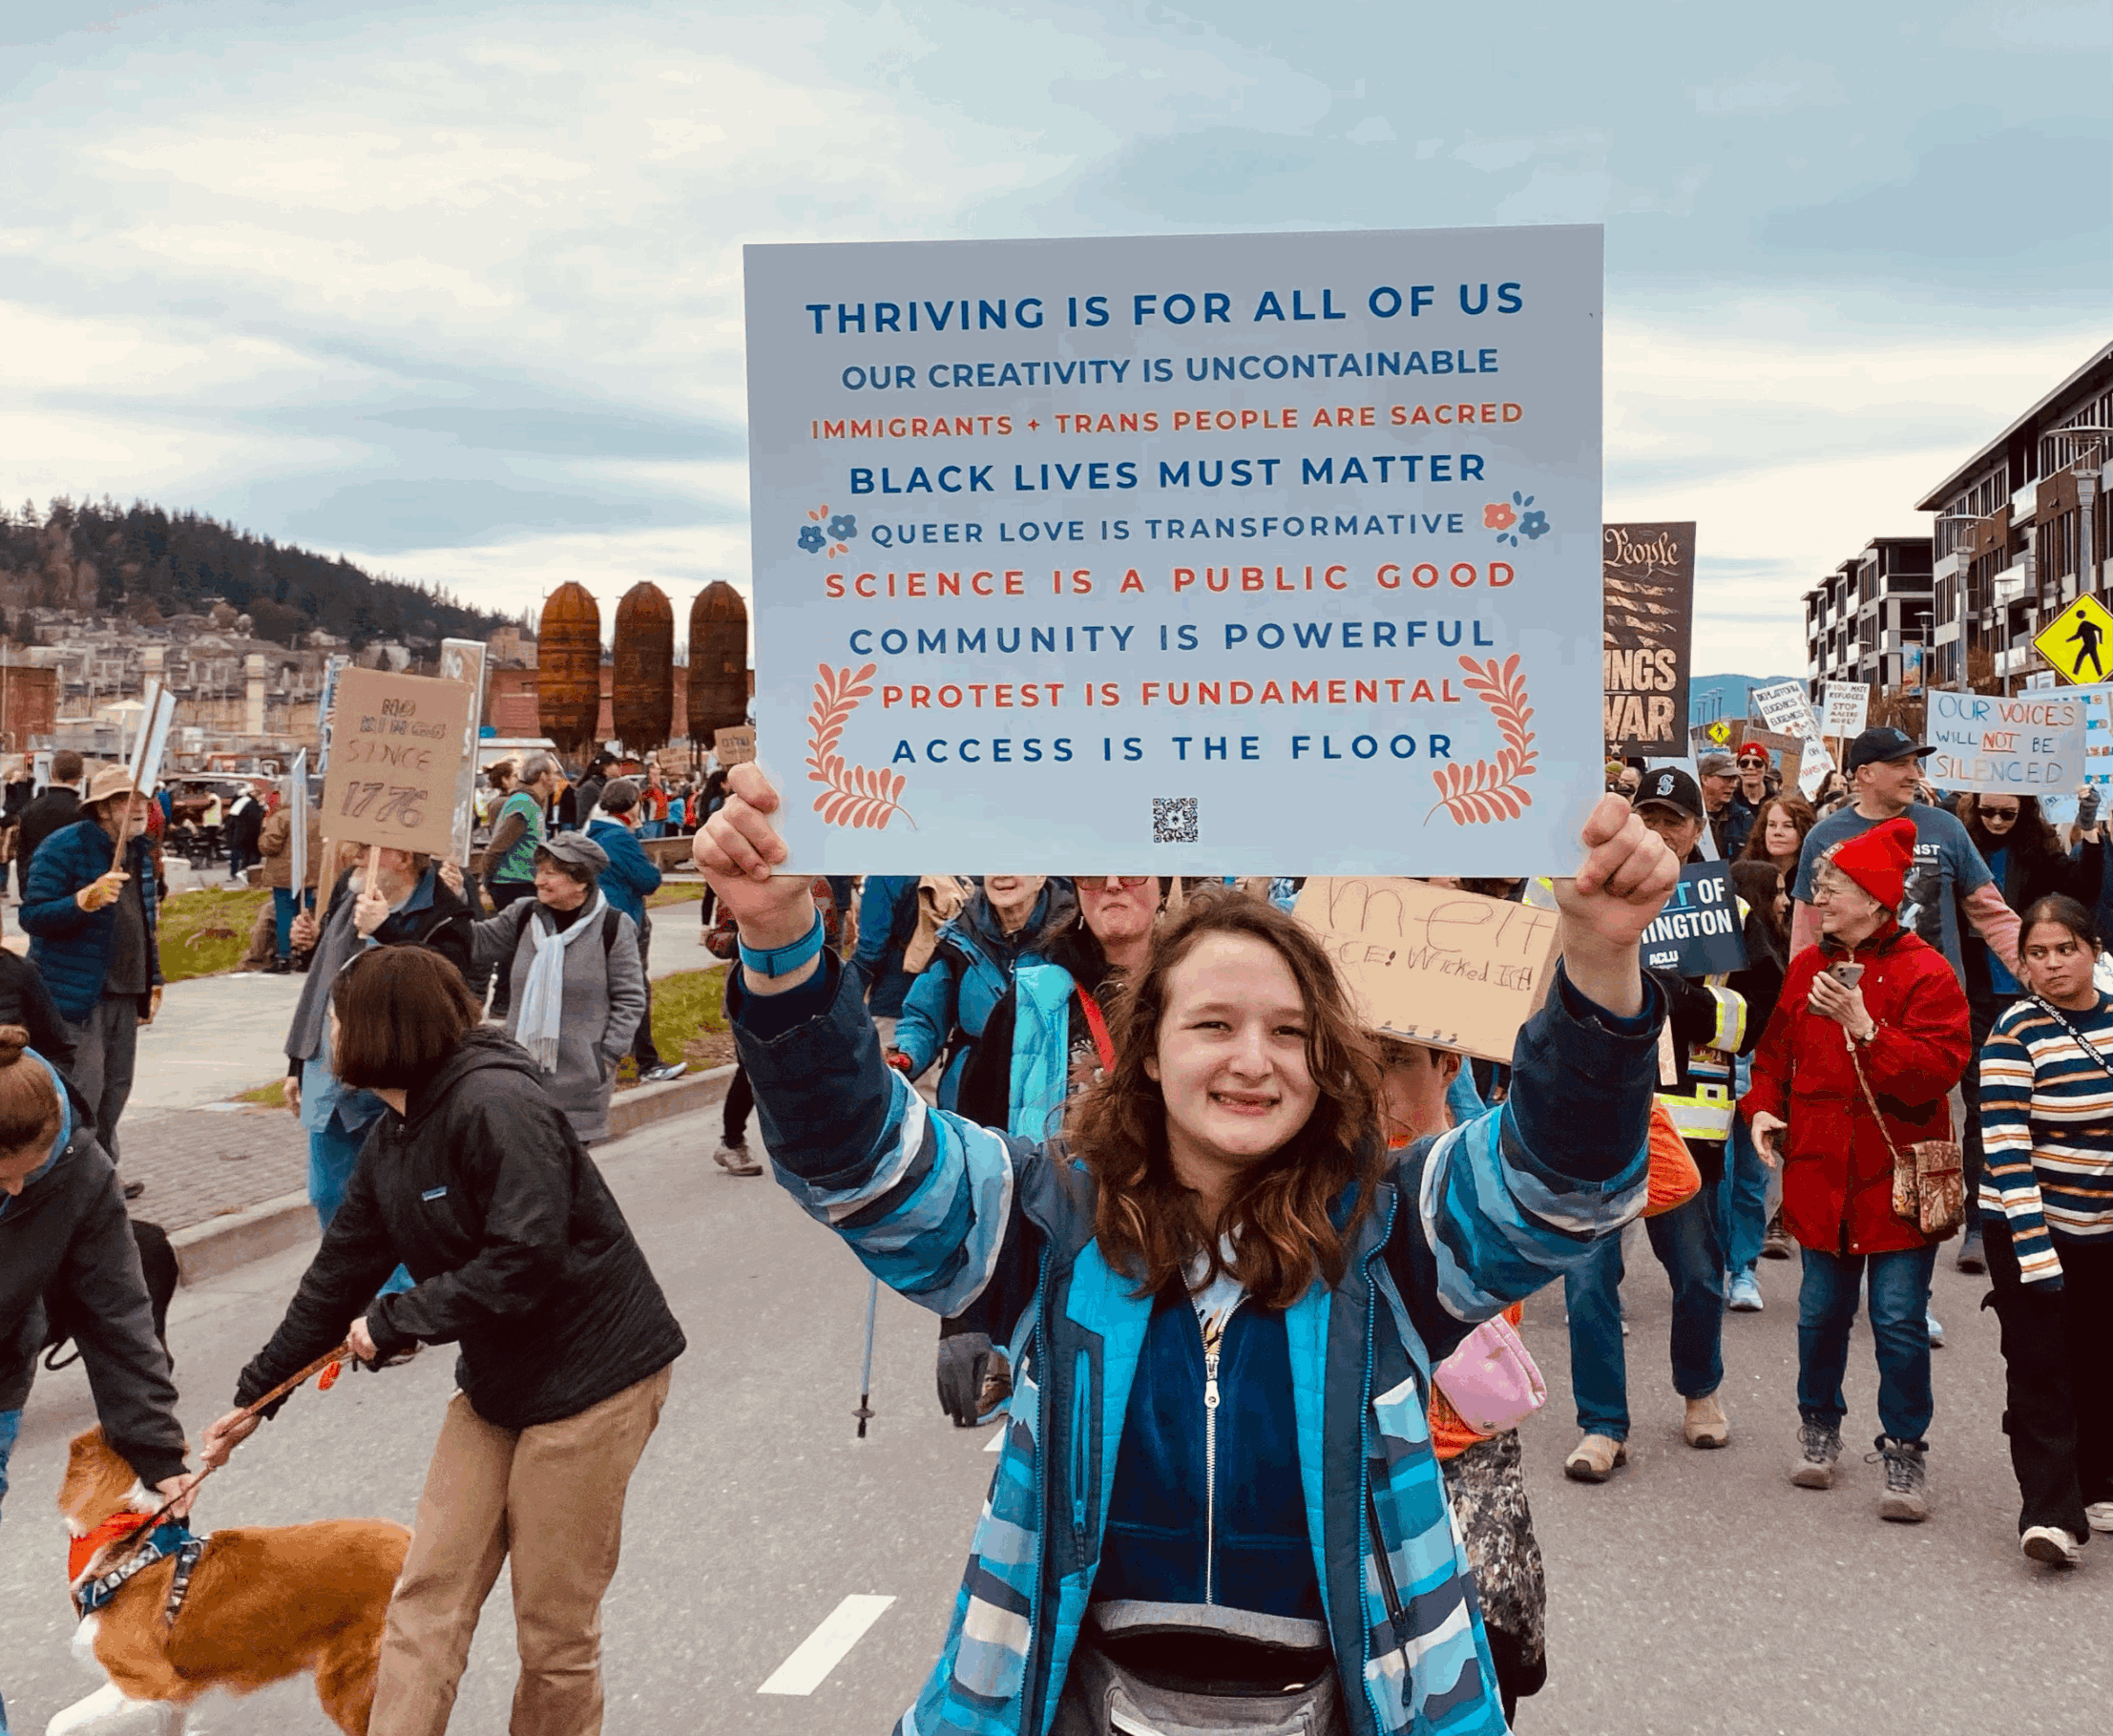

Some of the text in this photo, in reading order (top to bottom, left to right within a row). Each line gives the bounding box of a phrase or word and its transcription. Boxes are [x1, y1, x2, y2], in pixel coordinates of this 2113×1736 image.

[805, 282, 1523, 335] THRIVING IS FOR ALL OF US
[842, 348, 1499, 390] OUR CREATIVITY IS UNCONTAINABLE
[812, 402, 1523, 440] IMMIGRANTS + TRANS PEOPLE ARE SACRED
[849, 453, 1485, 495] BLACK LIVES MUST MATTER
[870, 512, 1464, 549] QUEER LOVE IS TRANSFORMATIVE
[1604, 527, 1680, 580] People
[825, 561, 1515, 598] SCIENCE IS A PUBLIC GOOD
[848, 619, 1495, 656] COMMUNITY IS POWERFUL
[382, 699, 417, 718] NO
[882, 678, 1461, 709] PROTEST IS FUNDAMENTAL
[1832, 702, 1857, 711] STOP
[1938, 695, 1991, 722] OUR
[1998, 702, 2076, 727] VOICES
[360, 715, 447, 740] KINGS
[1935, 730, 2056, 754] WILL NOT BE
[346, 739, 433, 771] SINCE
[891, 733, 1452, 764] ACCESS IS THE FLOOR
[1934, 754, 2063, 784] SILENCED
[342, 781, 429, 828] 1776
[1698, 877, 1726, 904] OF
[1649, 950, 1680, 966] ACLU
[2039, 999, 2068, 1026] adidas
[2077, 1036, 2105, 1065] adidas
